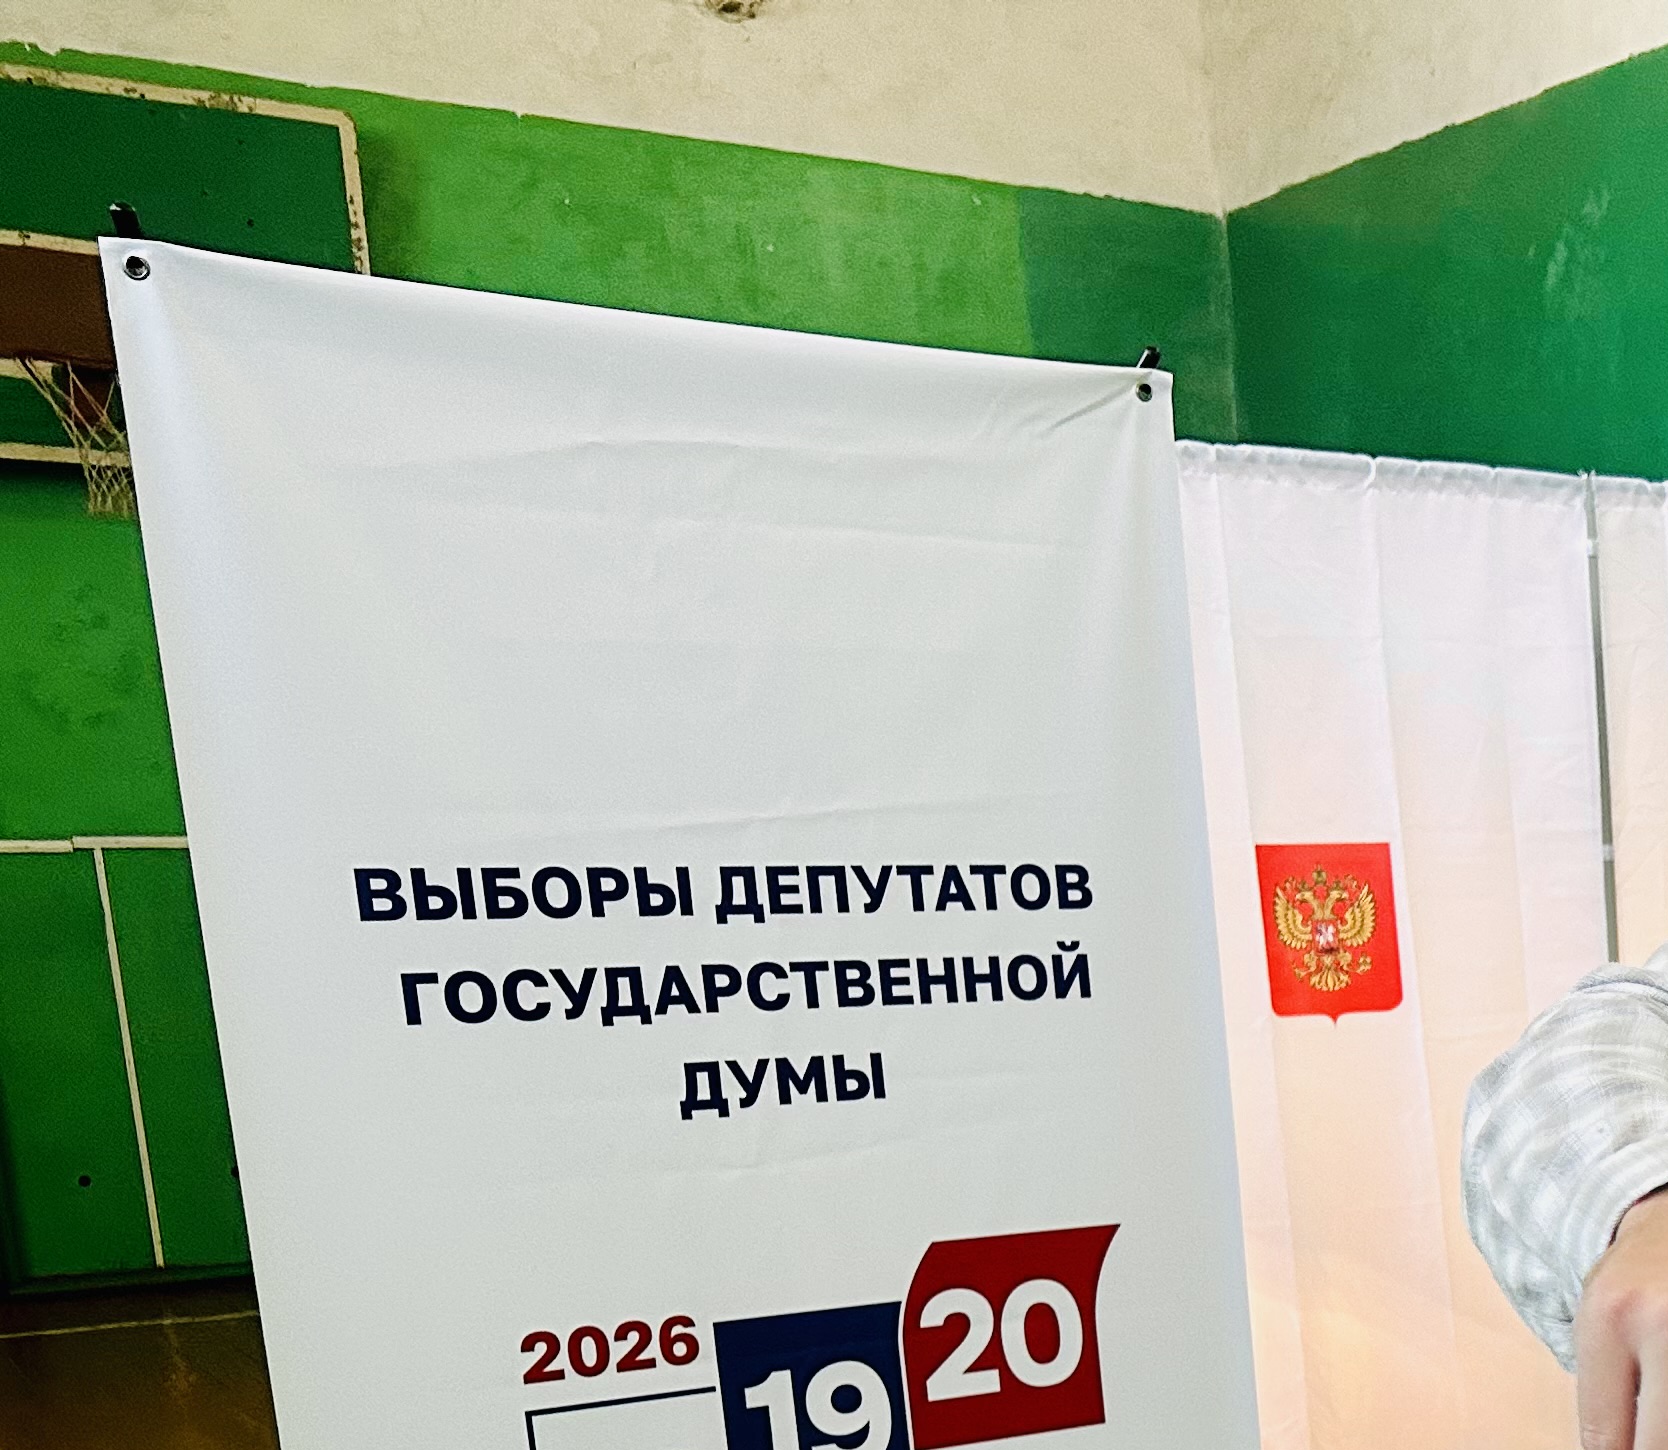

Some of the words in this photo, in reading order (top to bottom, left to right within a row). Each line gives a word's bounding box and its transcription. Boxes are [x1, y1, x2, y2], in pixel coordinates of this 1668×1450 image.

[353, 866, 694, 922] ВЫБОРЫ
[714, 863, 1094, 925] ДЕПУТАТОВ
[400, 940, 1093, 1027] ГОСУДАРСТВЕННОЙ
[679, 1052, 887, 1121] ДУМЫ
[520, 1315, 700, 1384] 2026
[919, 1279, 1083, 1402] 20
